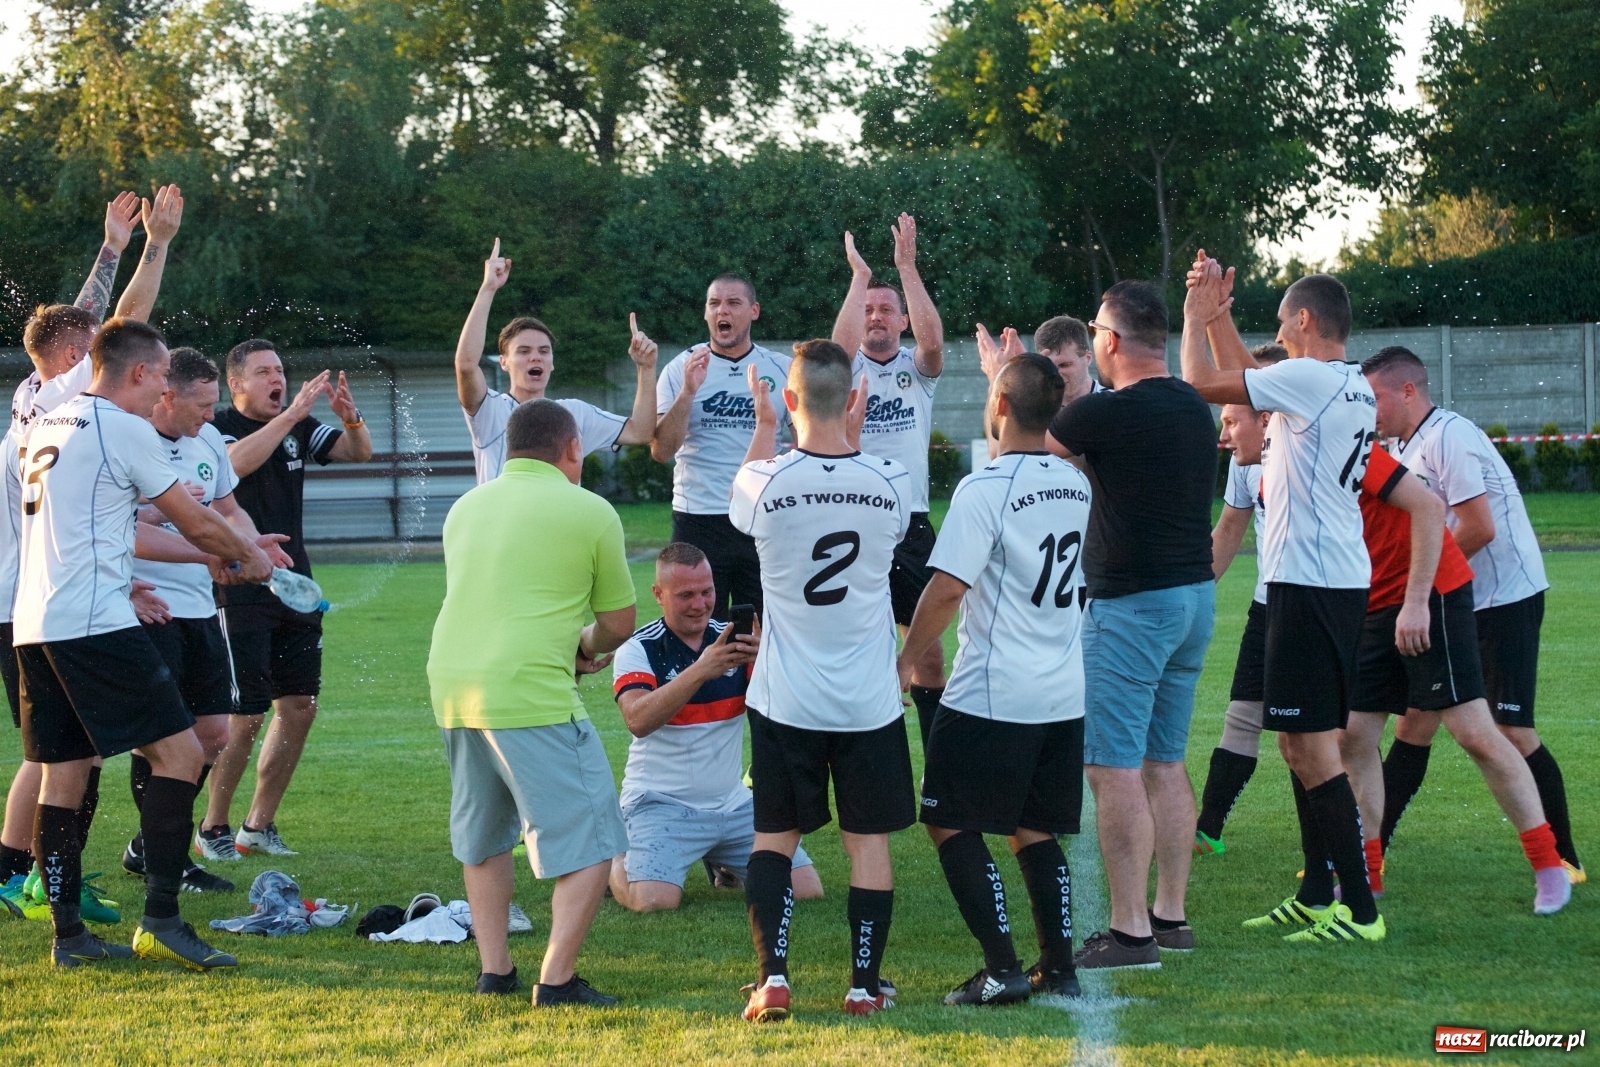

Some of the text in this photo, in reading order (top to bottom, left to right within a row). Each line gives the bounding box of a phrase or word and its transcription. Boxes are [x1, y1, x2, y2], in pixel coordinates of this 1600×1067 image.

[763, 493, 896, 513] LKS TWORKÓW
[1011, 494, 1036, 513] LKS
[803, 530, 860, 606] 2
[1030, 530, 1081, 609] 12
[981, 983, 1006, 1002] adidas
